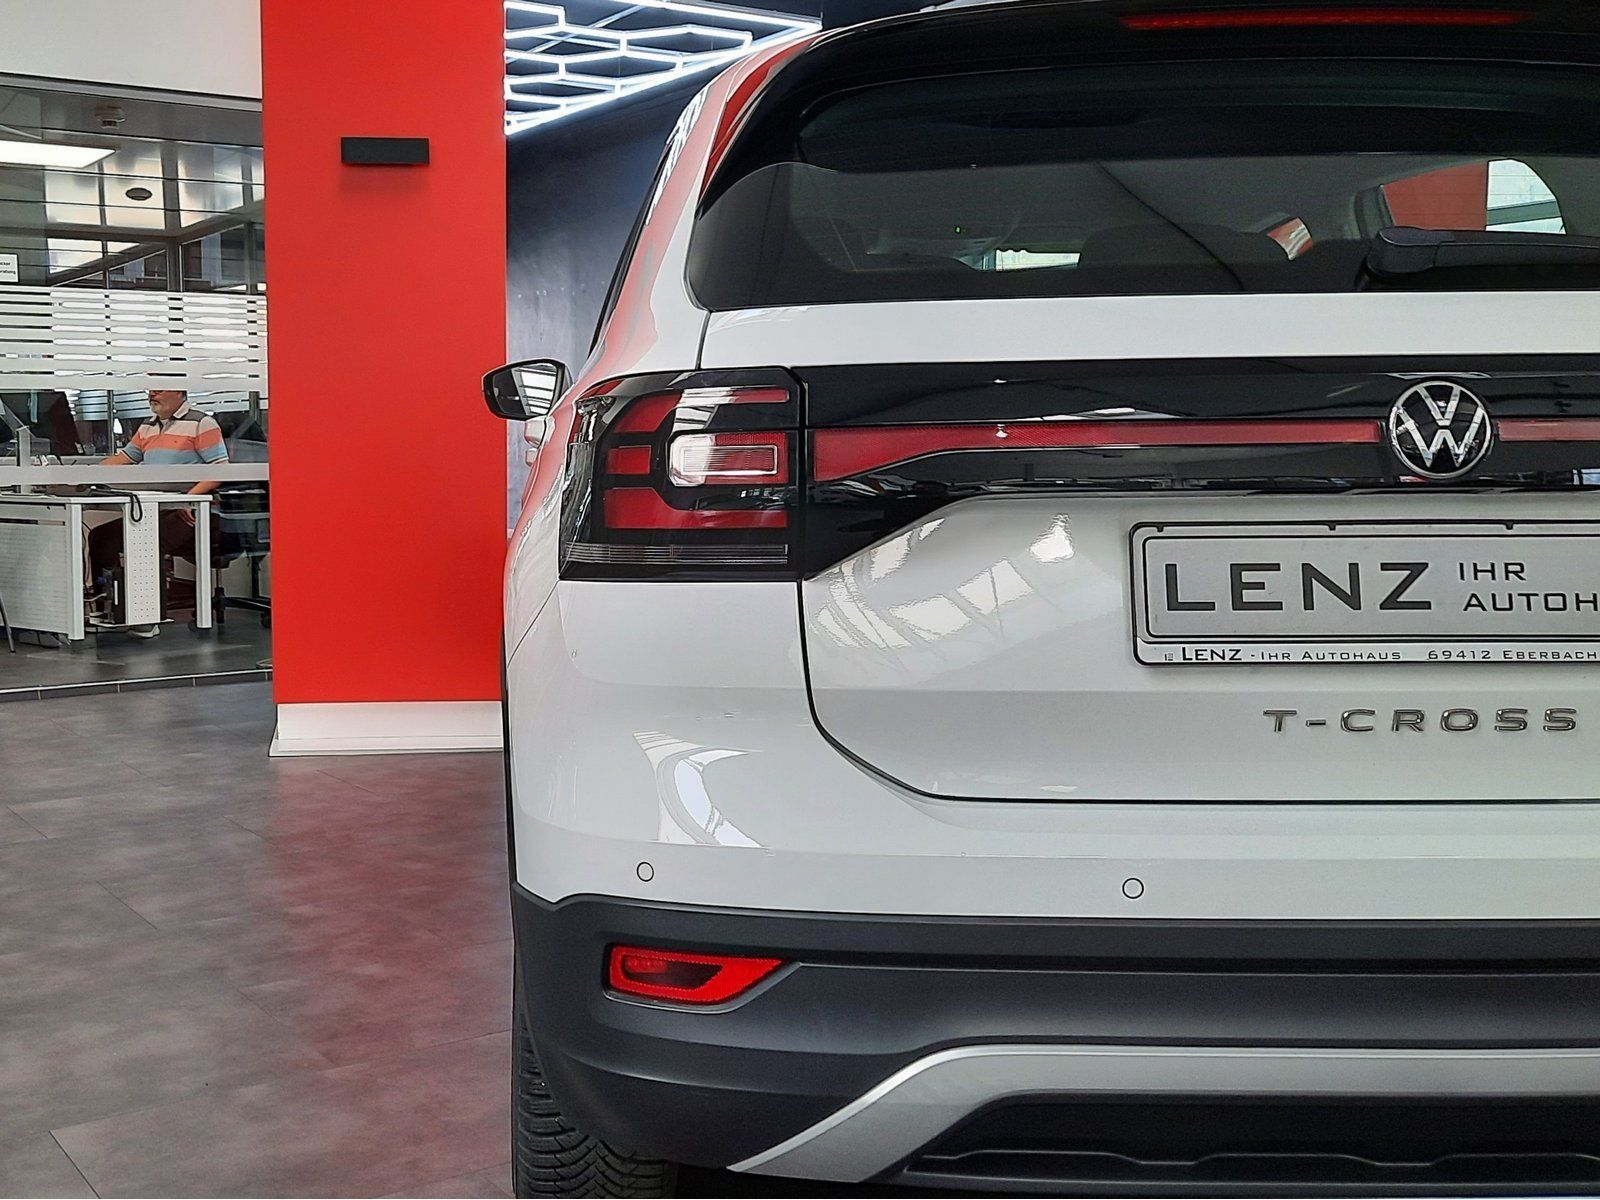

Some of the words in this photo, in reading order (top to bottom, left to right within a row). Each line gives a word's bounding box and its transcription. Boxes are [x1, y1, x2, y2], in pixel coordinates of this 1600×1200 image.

[1458, 562, 1527, 582] IHR
[1164, 562, 1433, 612] LENZ
[1462, 592, 1599, 612] AUTOH
[1181, 646, 1243, 662] LENZ
[1260, 651, 1292, 661] IHR
[1301, 650, 1402, 661] AUTOHAUS
[1427, 650, 1492, 660] 69412
[1502, 650, 1599, 660] EBERBACH
[1263, 708, 1578, 733] T-CROSS
